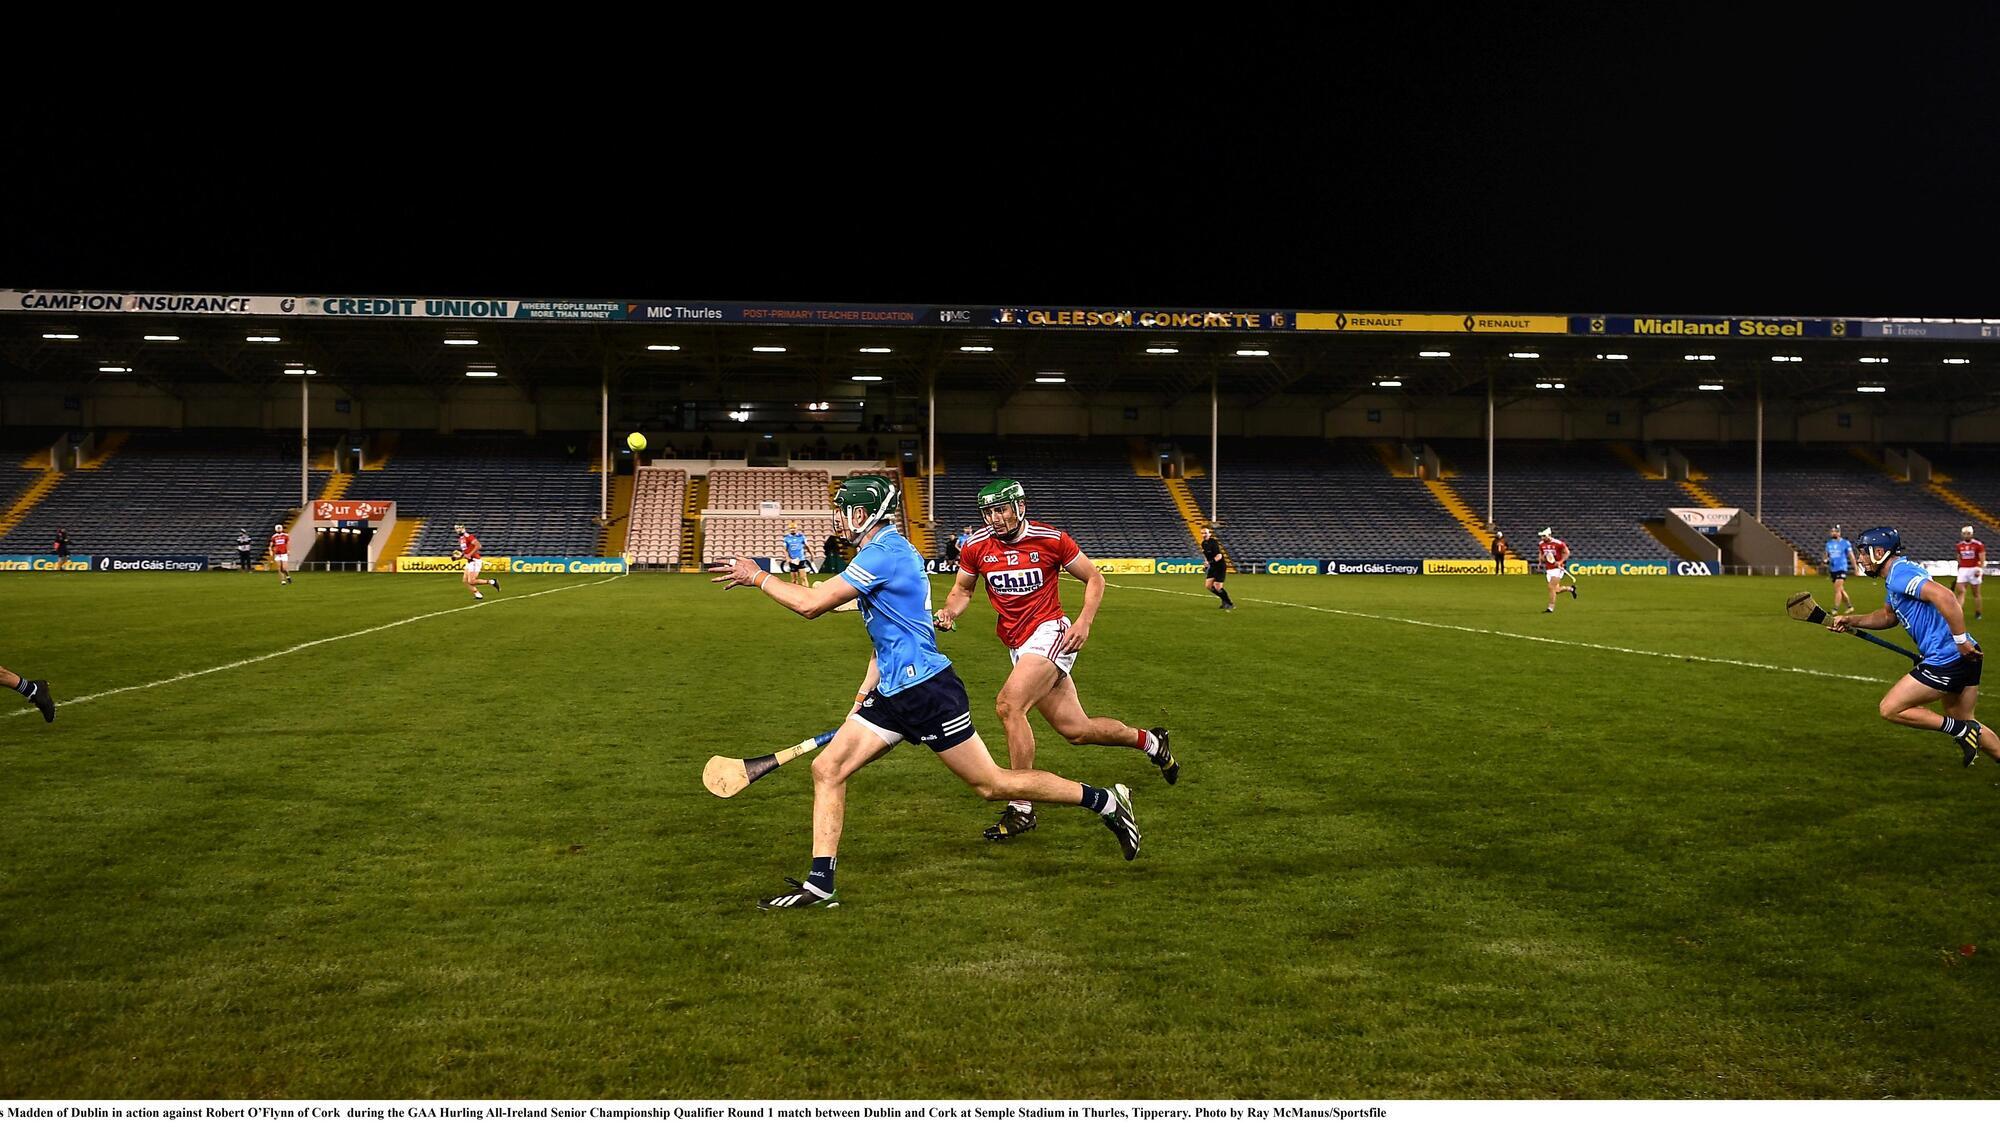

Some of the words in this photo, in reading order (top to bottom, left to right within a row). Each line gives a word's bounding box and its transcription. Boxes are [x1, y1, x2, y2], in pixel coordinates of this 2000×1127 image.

[21, 294, 123, 309] CAMPION
[131, 296, 250, 312] INSURANCE
[323, 298, 416, 315] CREDIT
[424, 299, 508, 316] UNION
[521, 302, 550, 310] WHERE
[552, 303, 585, 311] PEOPLE
[531, 310, 554, 318] MORE
[556, 310, 579, 318] THAN
[581, 310, 610, 319] MONEY
[647, 306, 673, 318] MIC
[675, 306, 722, 319] Thurles
[743, 308, 813, 319] POST-PRIMARY
[816, 309, 859, 320] TEACHER
[861, 310, 914, 321] EDUCATION
[1027, 310, 1132, 326] GLEESON
[1140, 311, 1260, 327] CONCRETE
[1351, 318, 1403, 327] RENAULT
[1479, 320, 1531, 328] RENAULT
[1633, 319, 1730, 336] Midland
[1738, 320, 1803, 336] Steel
[1896, 324, 1927, 336] Teneo
[335, 506, 350, 515] LIT
[113, 560, 140, 570] Bord
[141, 560, 164, 570] Gáis
[165, 560, 202, 572] Energy
[512, 560, 565, 573] Centra
[569, 560, 622, 573] Centra
[1006, 554, 1019, 566] 12
[1157, 561, 1206, 574] Centra
[1268, 562, 1317, 575] Centra
[1339, 563, 1362, 573] Bord
[1363, 563, 1384, 573] Gáis
[1385, 563, 1418, 575] Energy
[1428, 563, 1488, 574] Littlewoods
[1569, 563, 1616, 576] Centra
[1620, 563, 1668, 576] Centra
[1677, 561, 1712, 576] GAA
[990, 570, 1041, 588] Chill
